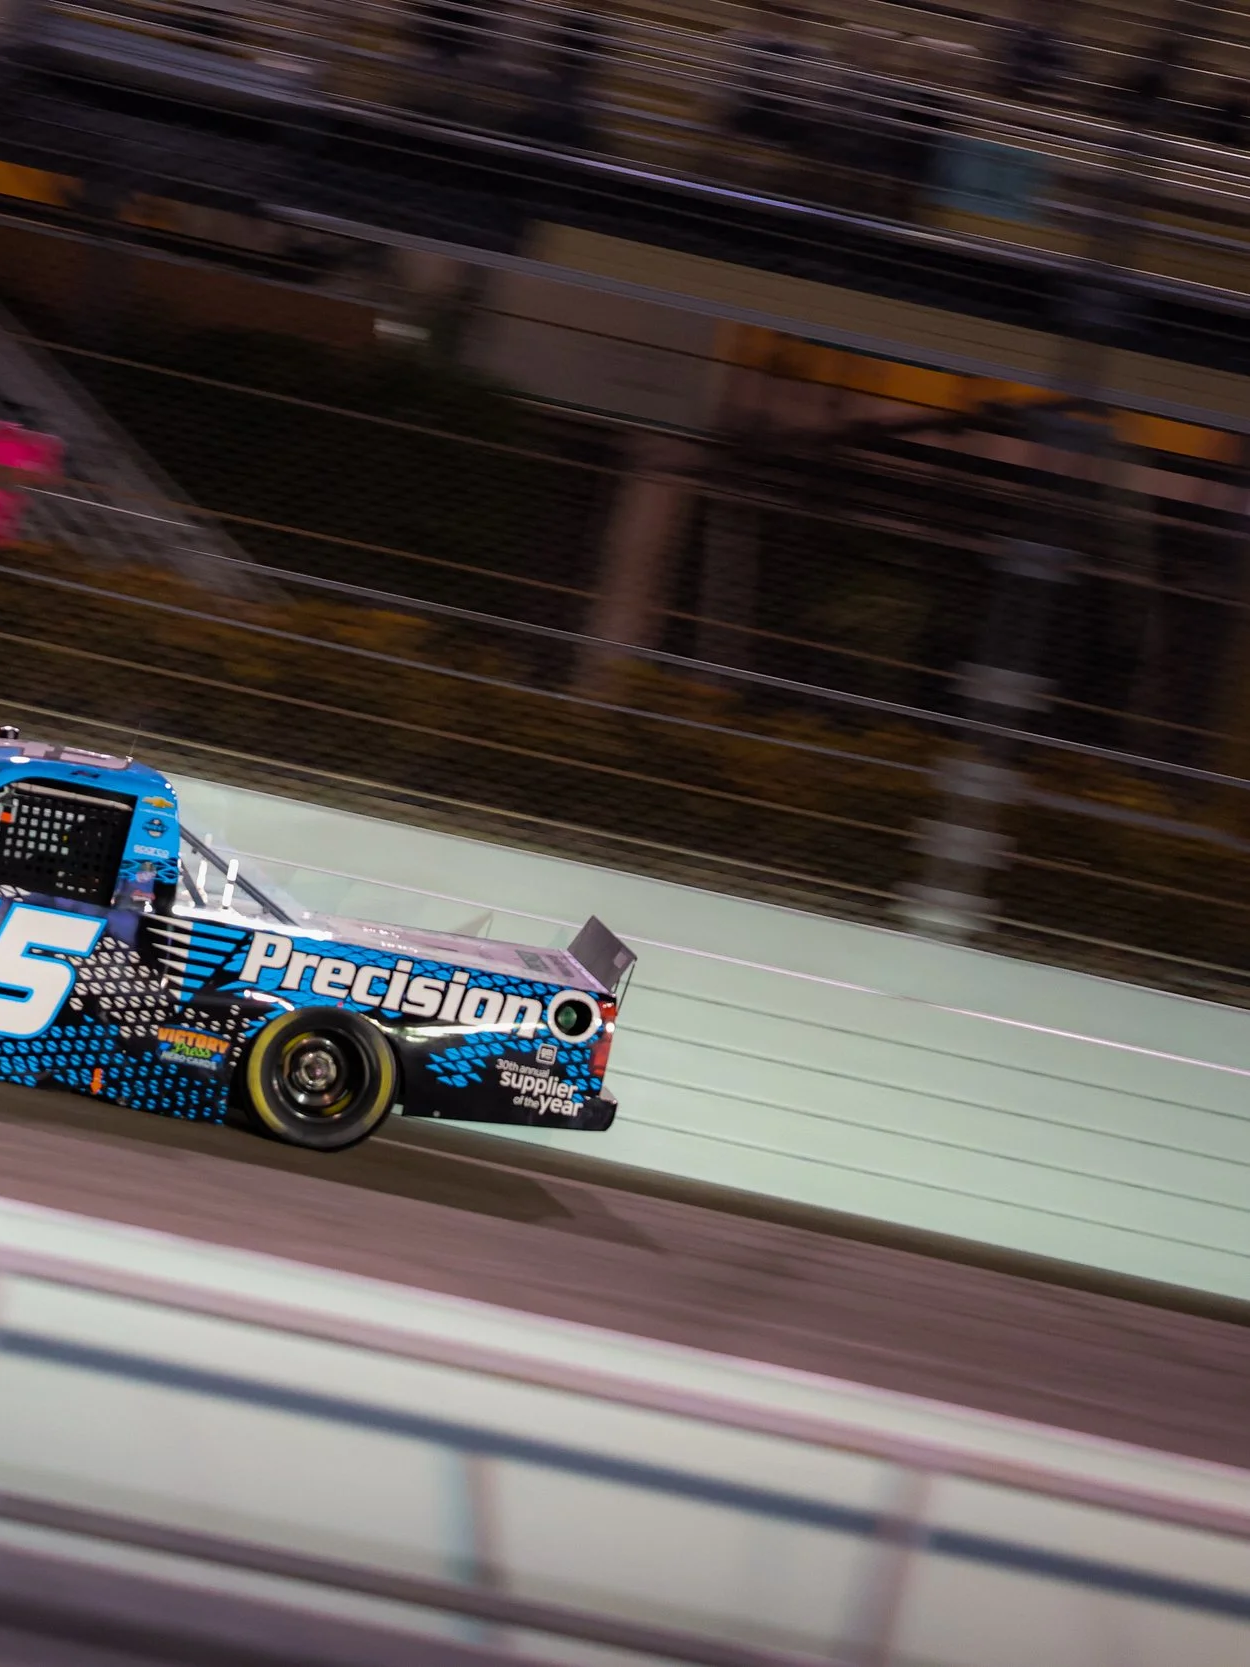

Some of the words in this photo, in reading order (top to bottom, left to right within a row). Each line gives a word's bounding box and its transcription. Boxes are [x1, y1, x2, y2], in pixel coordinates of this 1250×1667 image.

[238, 931, 543, 1039] Precision
[157, 1027, 230, 1055] VICTORY
[496, 1058, 519, 1073] 30th
[519, 1064, 551, 1079] annual
[499, 1071, 579, 1099] supplier
[513, 1095, 525, 1106] of
[524, 1097, 540, 1110] the
[538, 1095, 584, 1117] year
